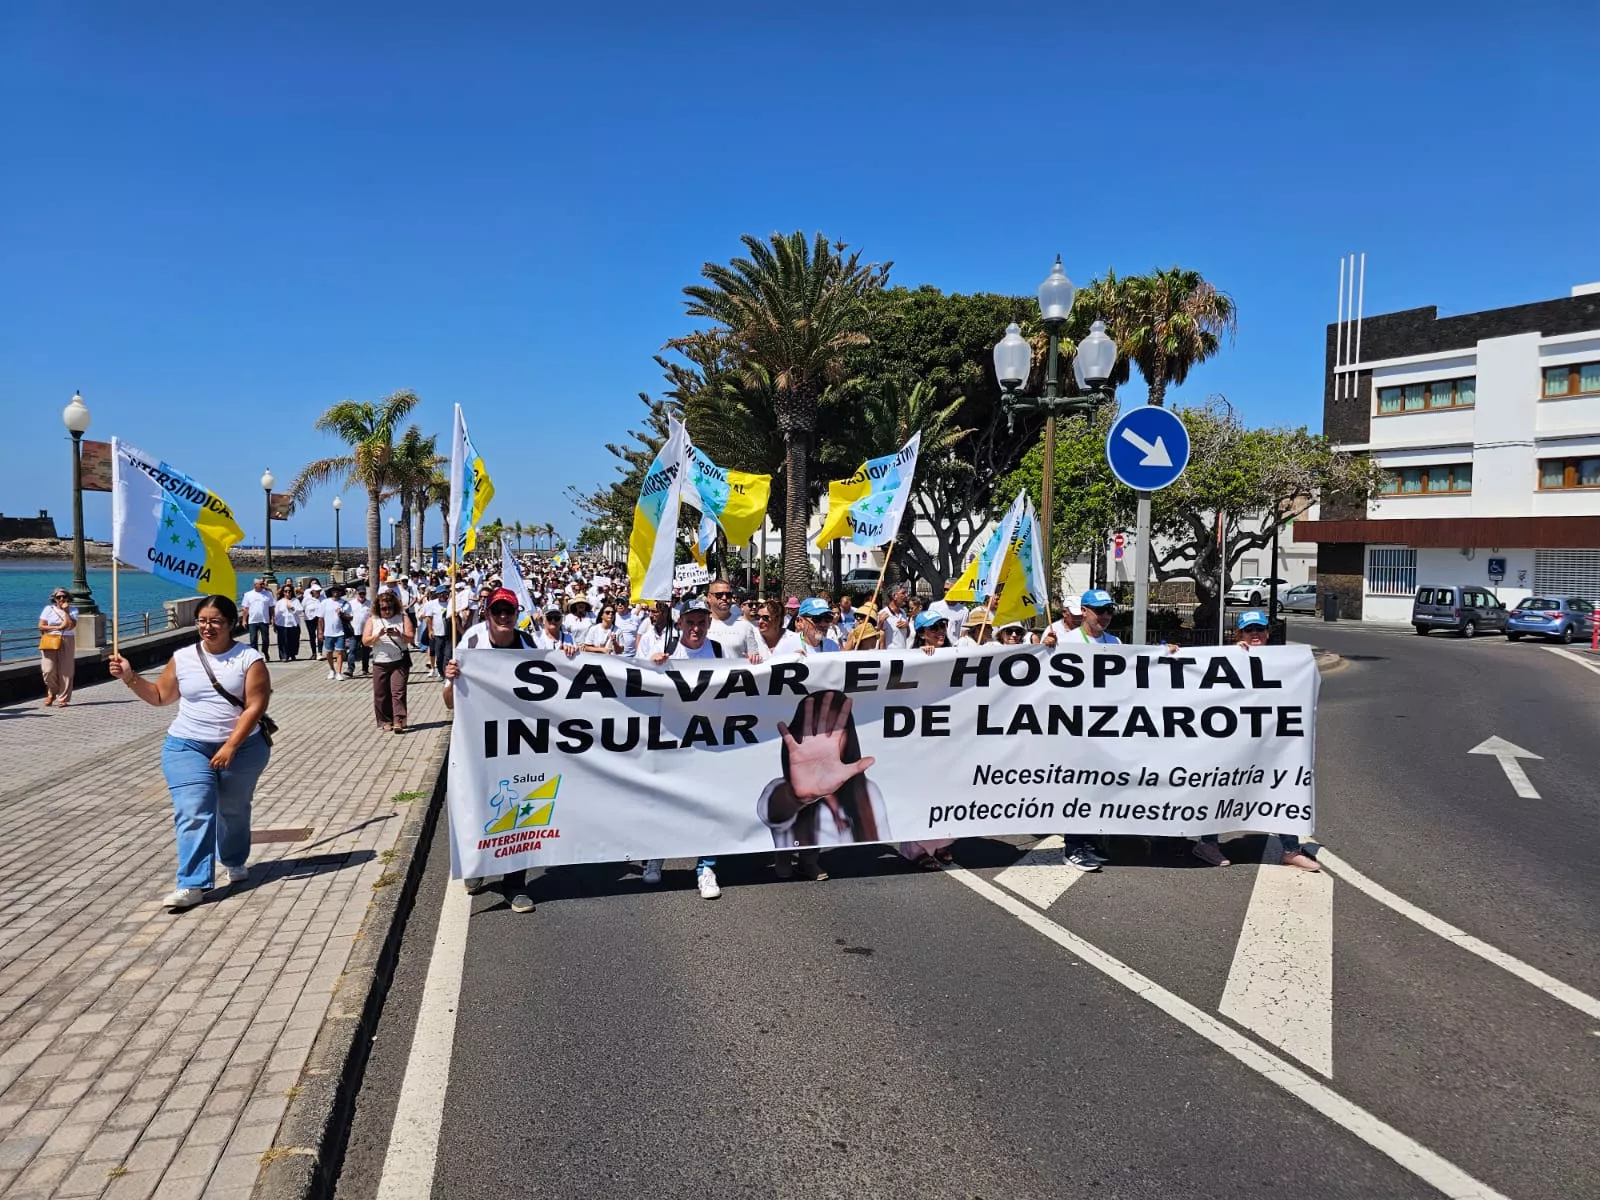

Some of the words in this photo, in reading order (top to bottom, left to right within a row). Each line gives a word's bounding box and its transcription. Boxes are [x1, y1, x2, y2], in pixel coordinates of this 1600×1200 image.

[147, 547, 212, 583] CANARIA
[512, 660, 810, 702] SALVAR
[843, 659, 919, 693] EL
[950, 653, 1282, 688] HOSPITAL
[484, 714, 759, 758] INSULAR
[883, 705, 950, 738] DE
[976, 704, 1304, 738] LANZAROTE
[512, 773, 545, 784] Salud
[972, 764, 1131, 786] Necesitamos
[1137, 767, 1160, 787] la
[1169, 764, 1265, 787] Geriatría
[1270, 769, 1288, 789] y
[1294, 766, 1312, 786] la
[928, 797, 1055, 828] protección
[1062, 797, 1092, 818] de
[1099, 801, 1209, 821] nuestros
[1214, 799, 1312, 821] Mayores
[477, 829, 561, 850] INTERSINDICAL
[494, 841, 541, 858] CANARIA
